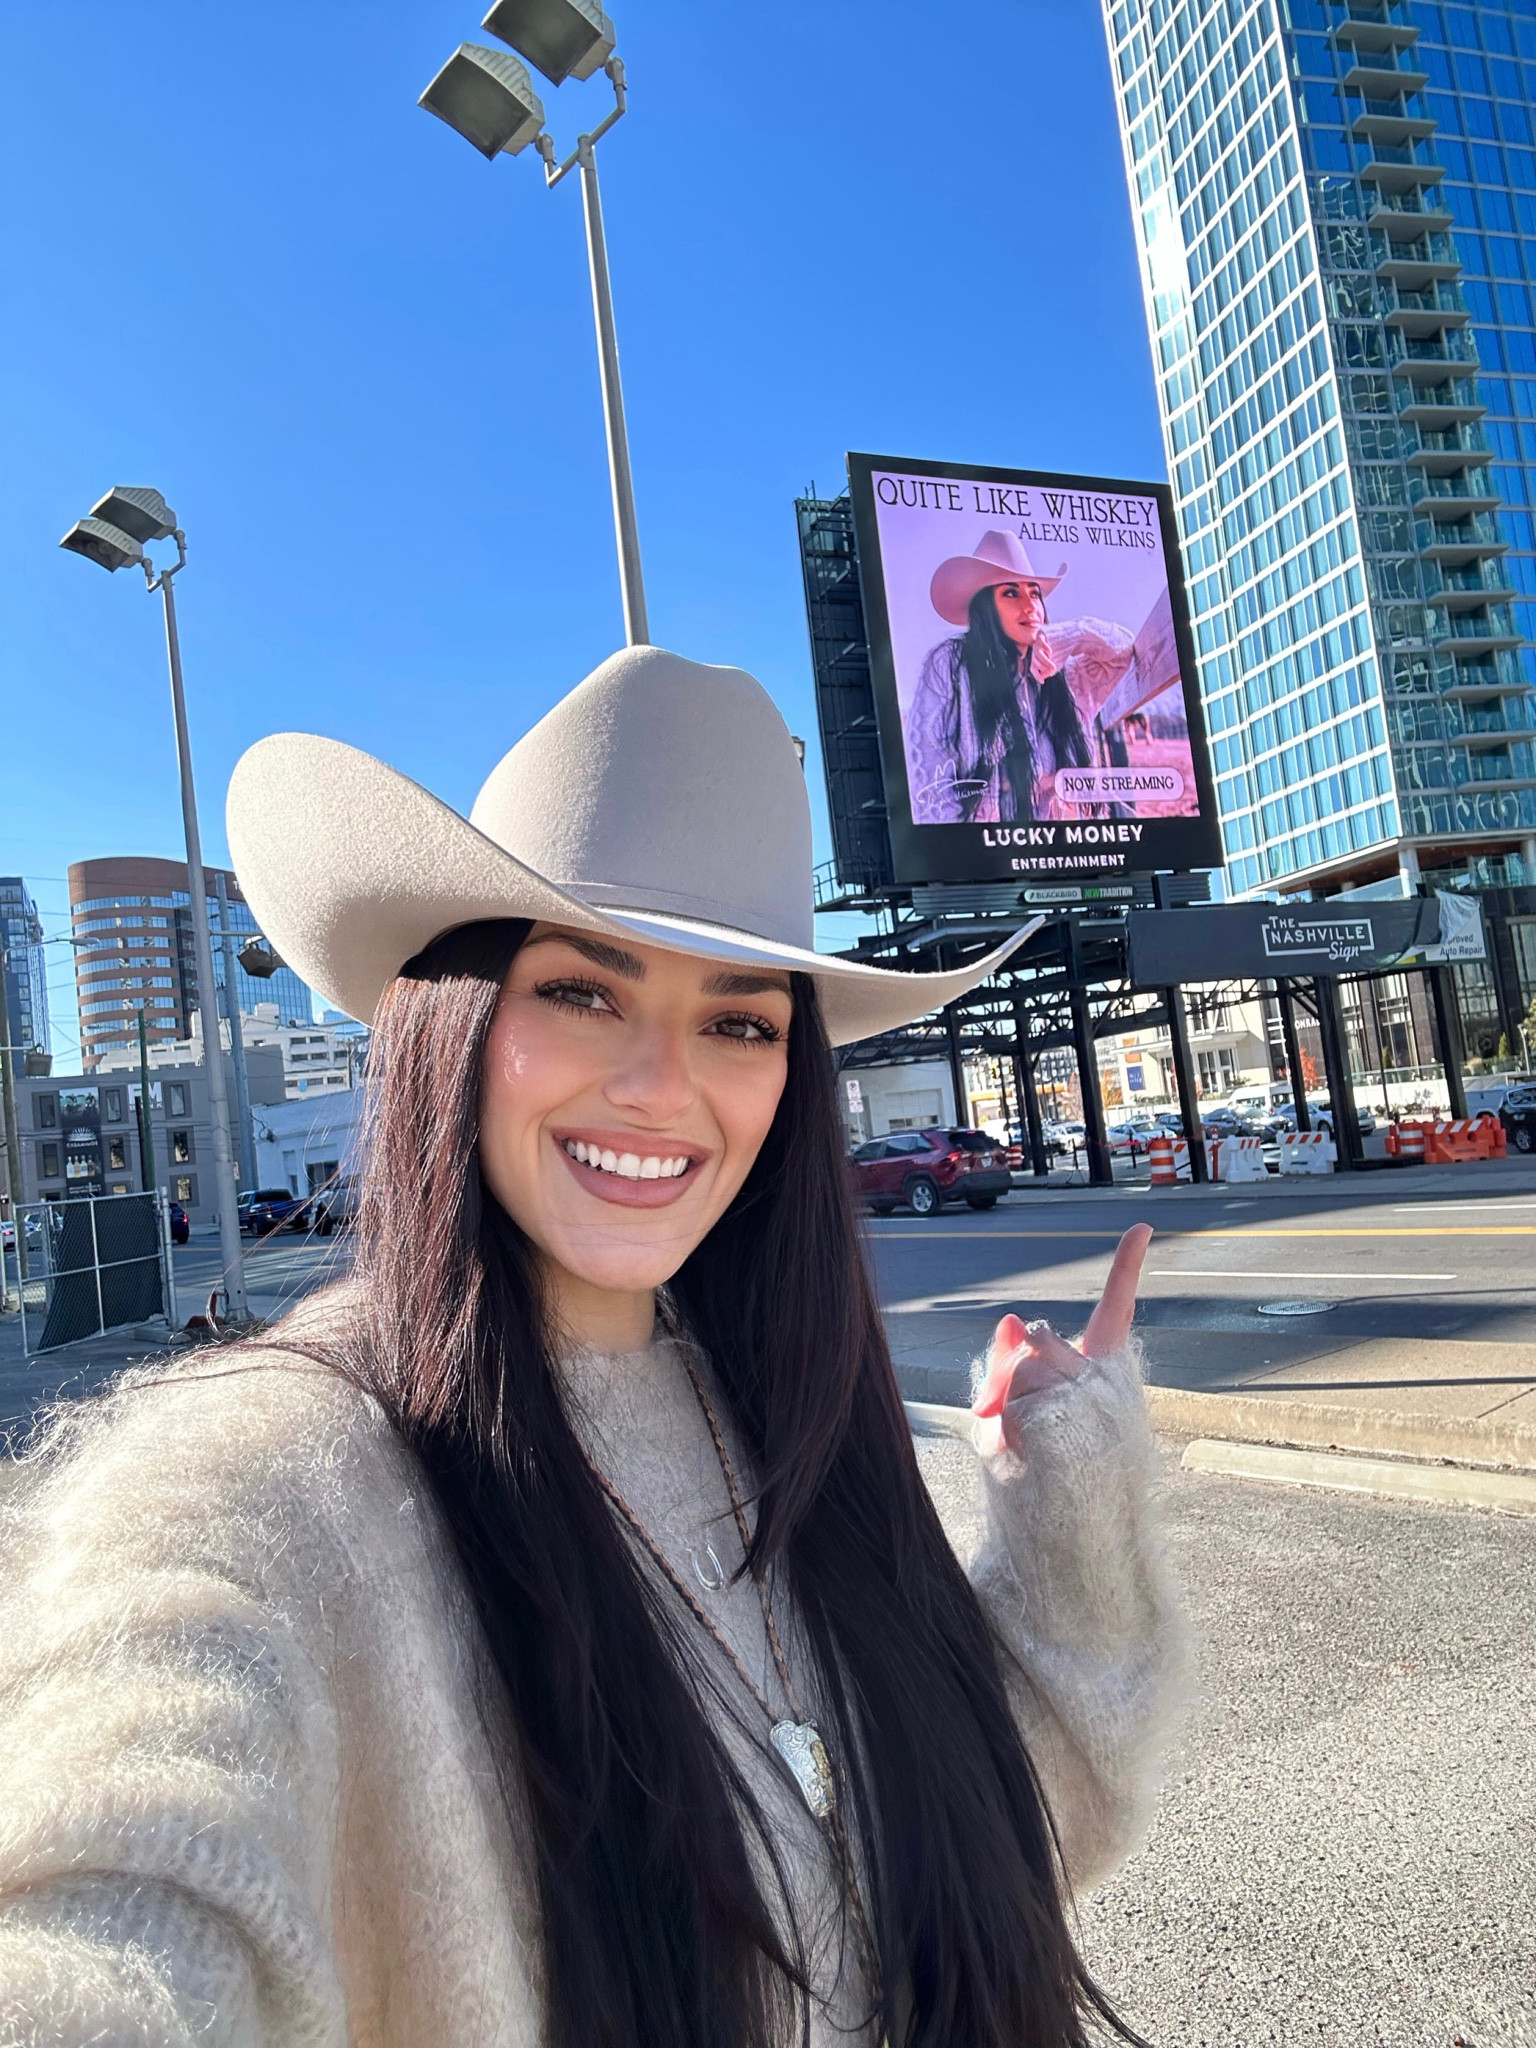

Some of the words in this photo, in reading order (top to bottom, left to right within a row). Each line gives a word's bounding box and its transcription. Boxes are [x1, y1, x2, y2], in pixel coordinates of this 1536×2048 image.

[877, 477, 963, 511] QUITE
[973, 486, 1031, 517] LIKE
[1041, 492, 1154, 527] WHISKEY
[1018, 522, 1080, 544] ALEXIS
[1085, 526, 1156, 549] WILKINS
[1065, 777, 1096, 791] NOW
[1101, 776, 1174, 790] STREAMING
[983, 827, 1056, 847] LUCKY
[1066, 824, 1144, 843] MONEY
[1011, 854, 1125, 870] ENTERTAINMENT
[1036, 890, 1078, 899] BLACKBIRD
[1268, 916, 1296, 929] THE
[1270, 926, 1365, 944] NASHVILLE
[1328, 941, 1360, 962] Sign
[1459, 945, 1483, 955] Repair
